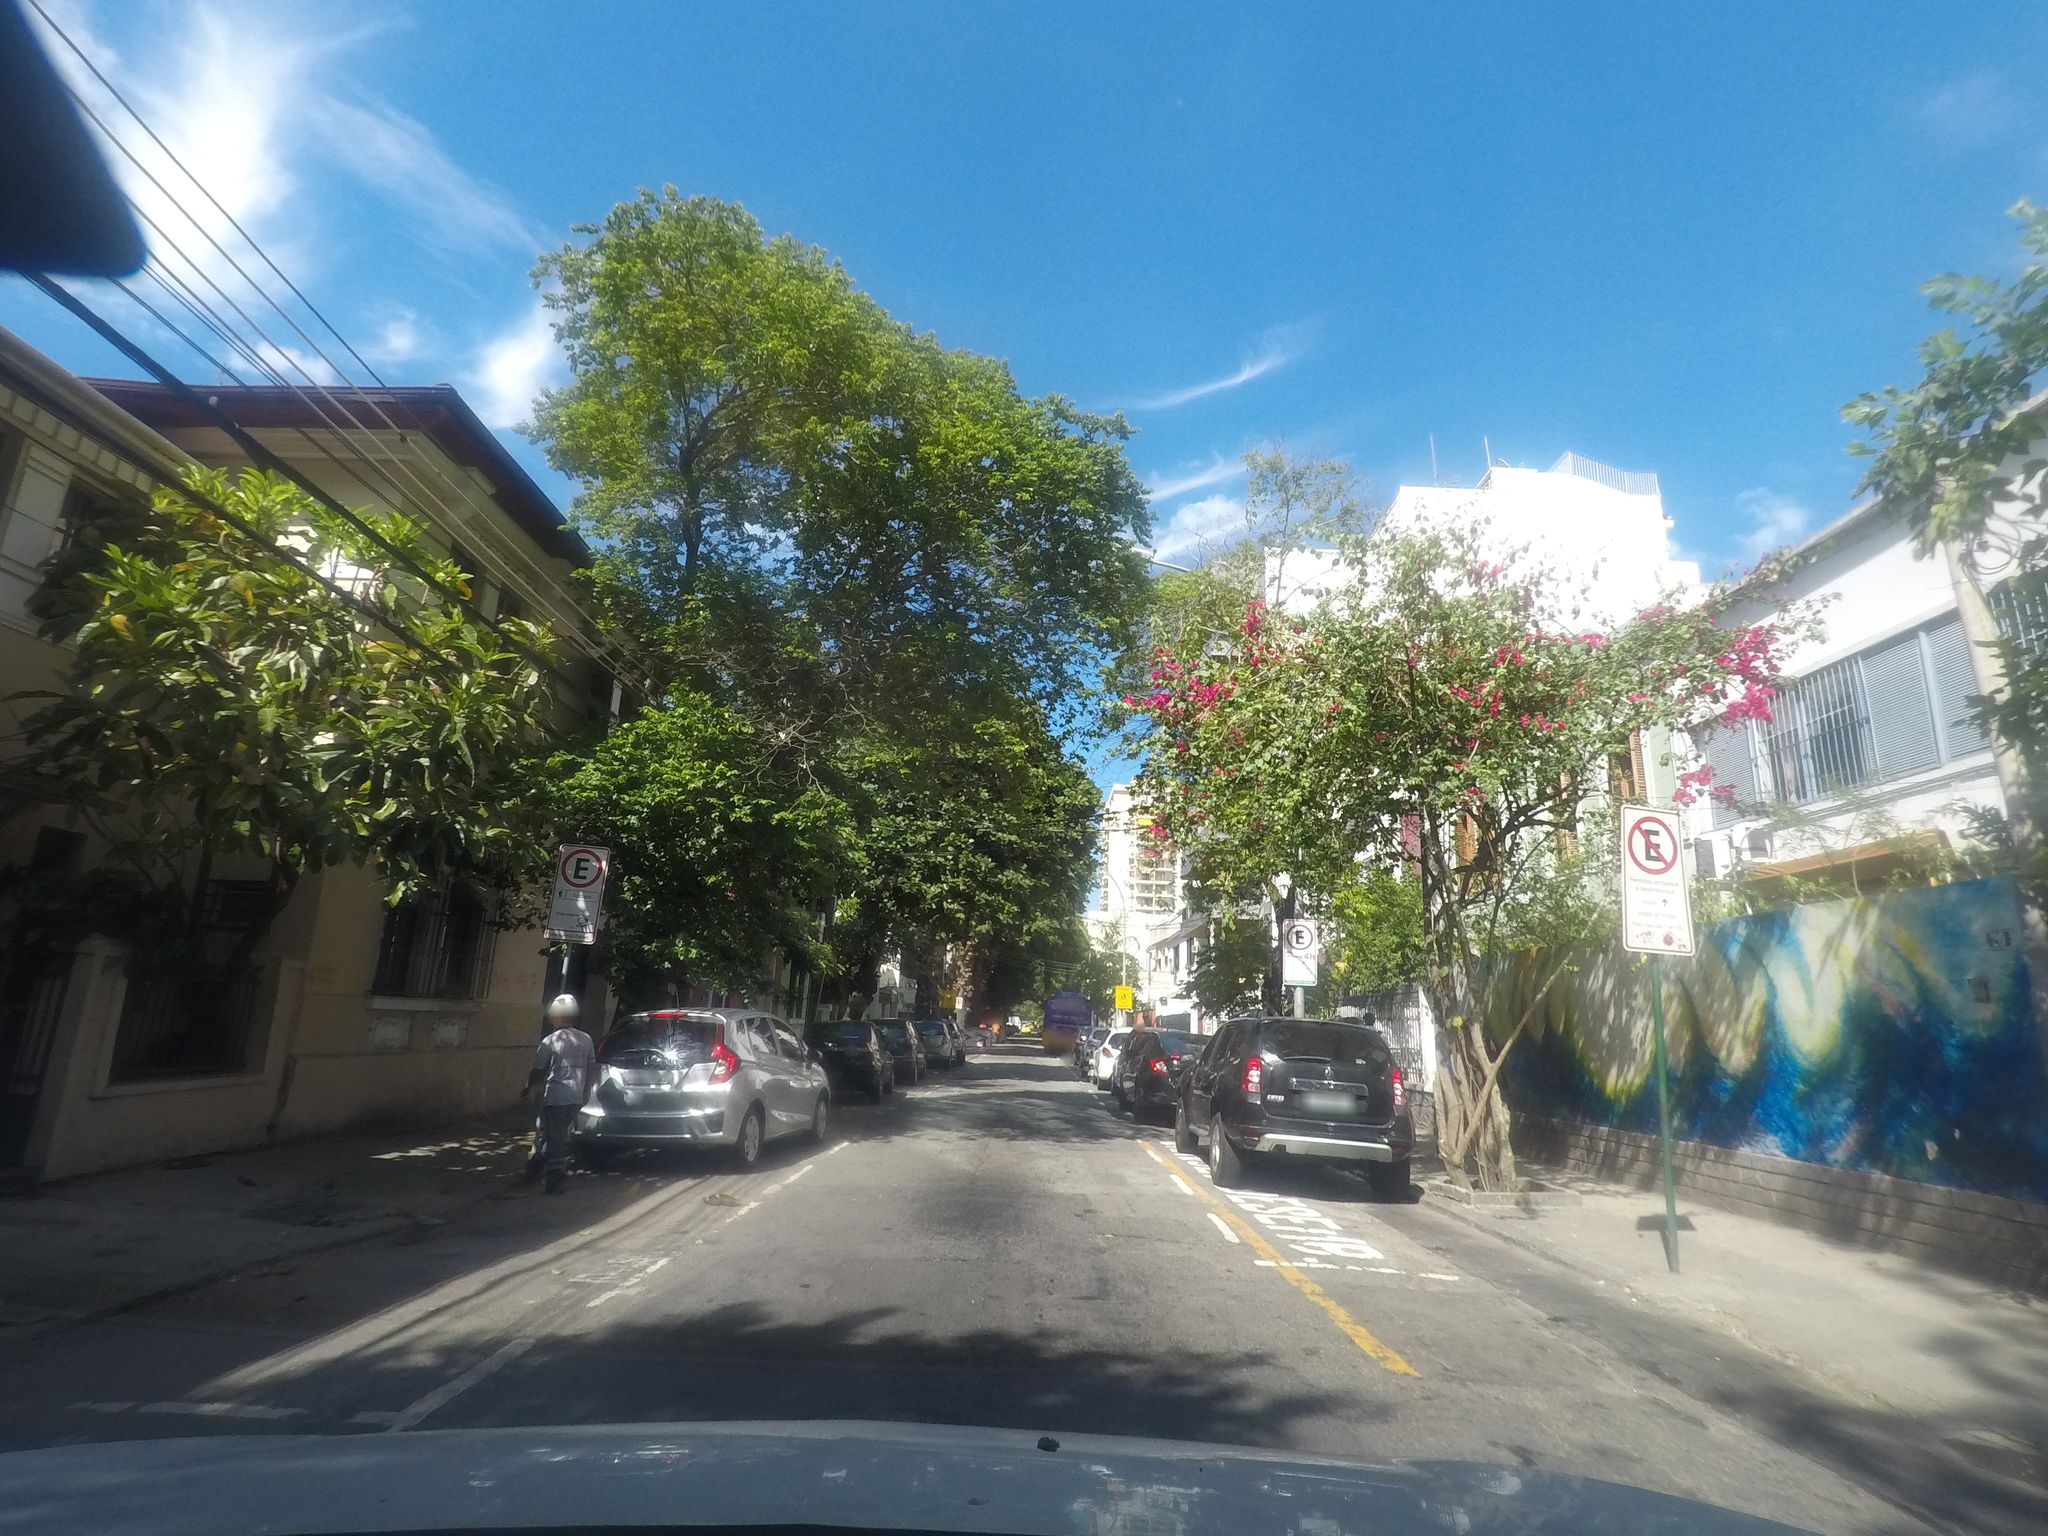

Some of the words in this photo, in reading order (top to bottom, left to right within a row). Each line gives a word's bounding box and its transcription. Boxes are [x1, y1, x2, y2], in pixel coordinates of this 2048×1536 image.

[1644, 829, 1663, 862] E
[573, 858, 590, 880] E
[1295, 930, 1304, 944] E
